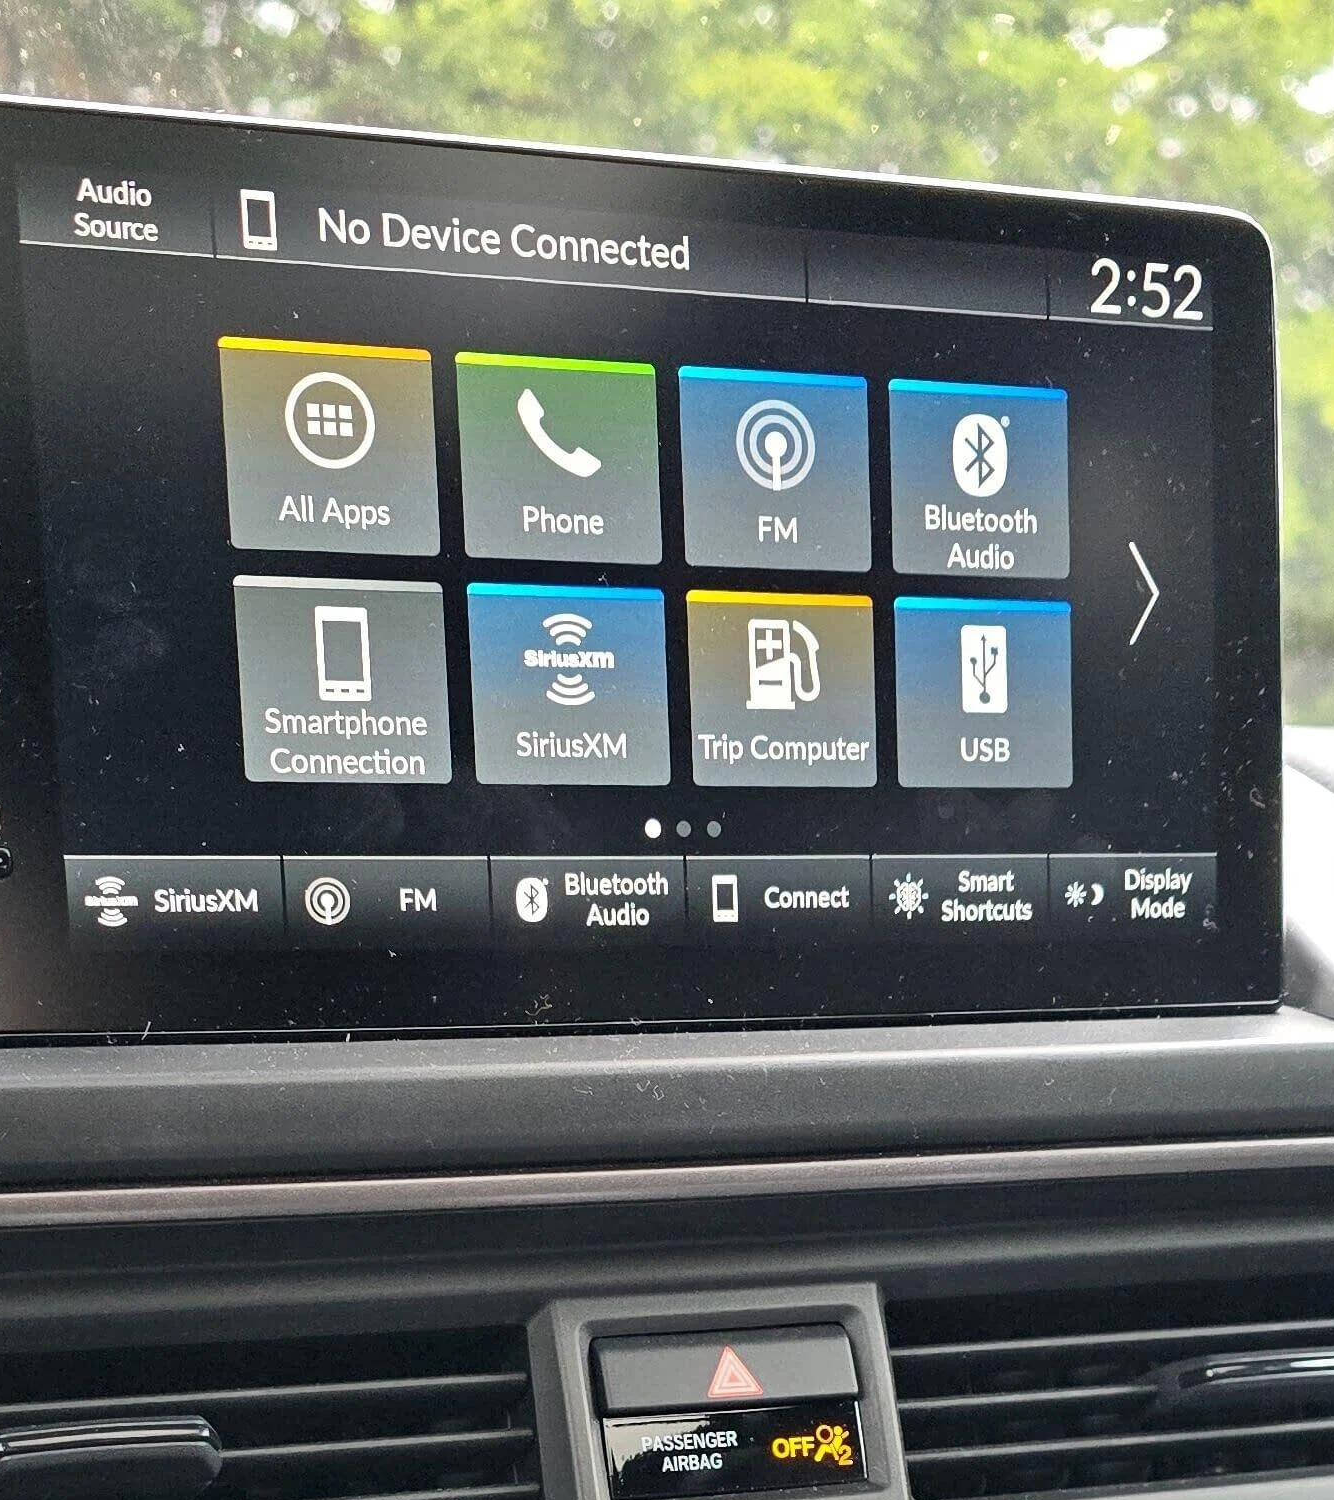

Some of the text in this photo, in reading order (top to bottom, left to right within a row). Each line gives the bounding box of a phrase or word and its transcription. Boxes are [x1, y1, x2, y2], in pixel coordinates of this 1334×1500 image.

[75, 178, 152, 208] Audio
[73, 213, 159, 243] Source
[317, 208, 691, 272] No Device Connected
[1089, 257, 1204, 322] 2:52
[278, 495, 391, 529] All Apps
[521, 506, 605, 536] Phone
[923, 503, 1039, 536] Bluetooth
[757, 516, 799, 545] FM
[946, 543, 1015, 572] Audio
[264, 707, 428, 744] Smartphone
[515, 730, 628, 759] SiriusXM
[698, 733, 870, 768] Trip Computer
[960, 738, 1011, 763] USB
[269, 747, 427, 778] Connection
[564, 871, 669, 900] Bluetooth
[957, 868, 1015, 894] Smart
[1123, 867, 1193, 899] Display
[153, 887, 259, 914] SiriusXM
[399, 889, 438, 912] FM
[763, 885, 849, 911] Connect
[940, 898, 1033, 923] Shortcuts
[1130, 894, 1186, 920] Mode
[586, 901, 650, 928] Audio
[640, 1429, 738, 1452] PASSENGER
[771, 1434, 816, 1460] OFF
[661, 1452, 724, 1474] AIRBAG
